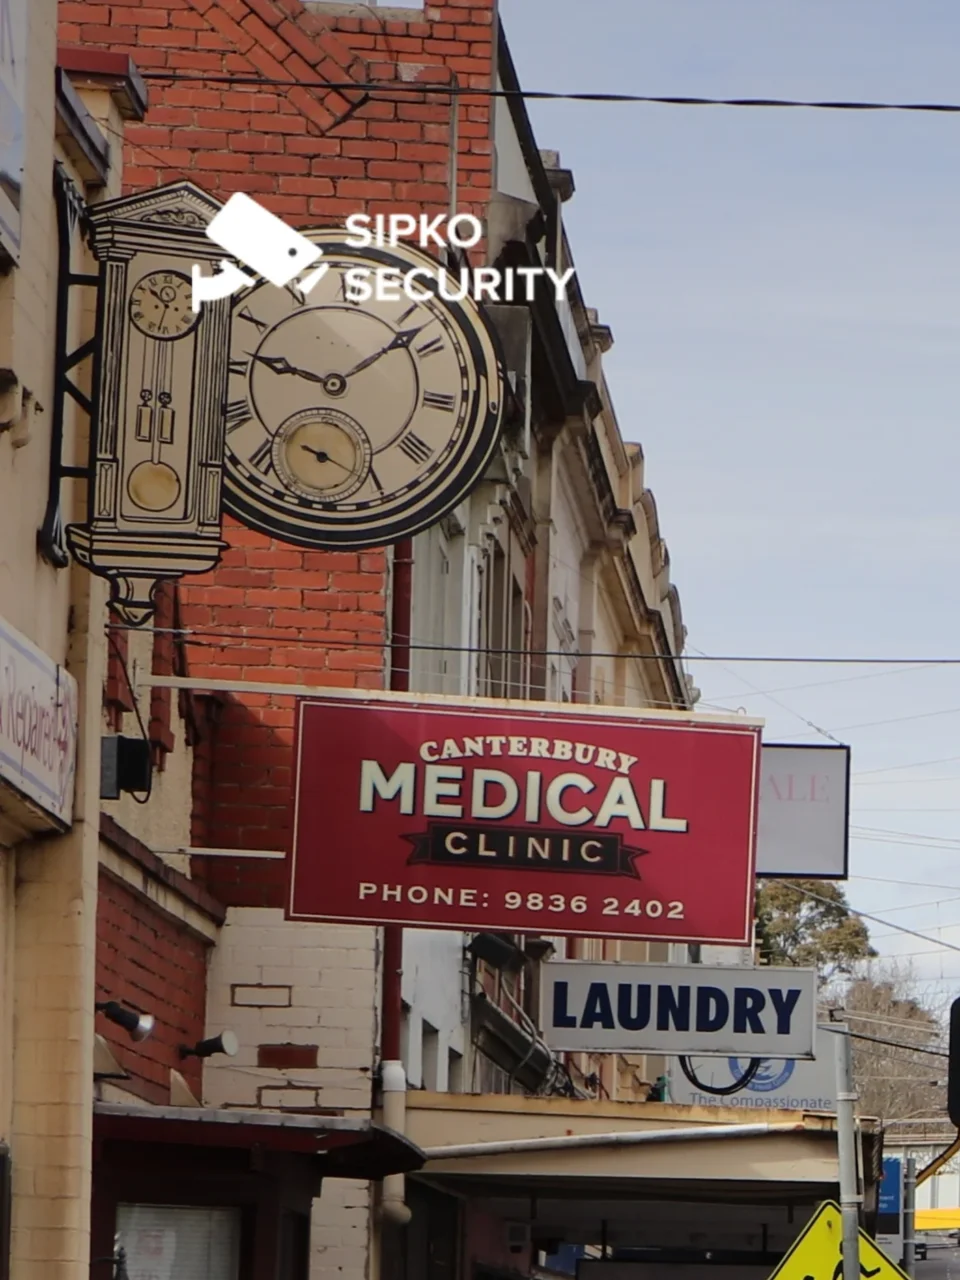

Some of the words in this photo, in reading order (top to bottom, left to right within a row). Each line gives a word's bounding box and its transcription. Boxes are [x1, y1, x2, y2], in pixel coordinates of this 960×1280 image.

[420, 736, 638, 774] CANTERBURY
[359, 759, 688, 832] MEDICAL
[445, 831, 604, 863] CLINIC
[358, 882, 490, 908] PHONE:
[504, 891, 588, 913] 9836
[602, 897, 685, 919] 2402
[552, 981, 802, 1035] LAUNDRY
[689, 1092, 717, 1104] The
[720, 1094, 832, 1109] Compassionate
